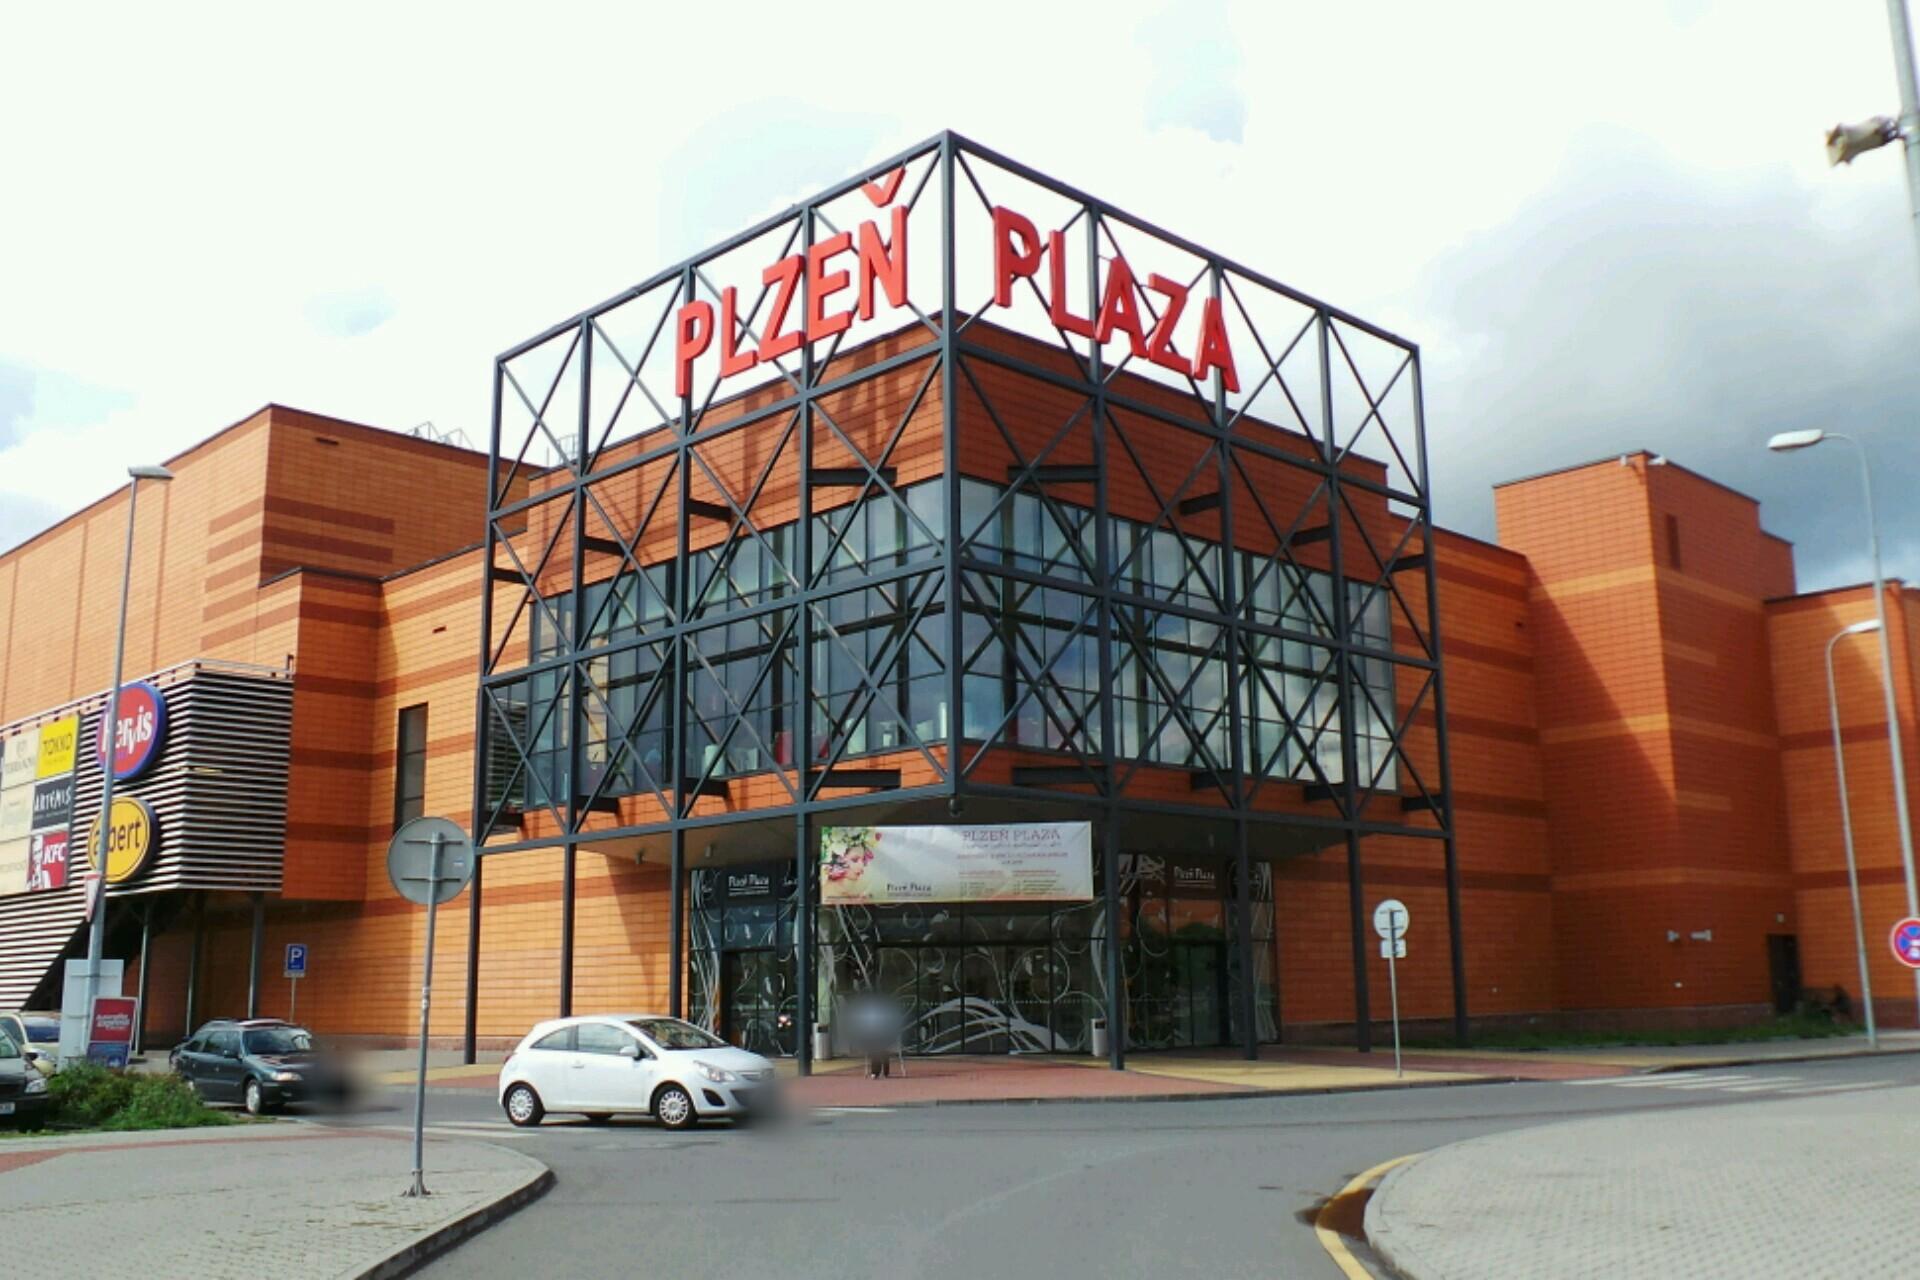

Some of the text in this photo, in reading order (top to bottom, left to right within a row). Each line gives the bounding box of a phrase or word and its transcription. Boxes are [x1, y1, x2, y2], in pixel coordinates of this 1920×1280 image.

[675, 167, 1240, 398] PLZEŇ PLAZA
[94, 820, 142, 856] bert
[1013, 828, 1061, 841] PLAZA
[43, 842, 67, 864] KFC
[291, 947, 303, 964] P
